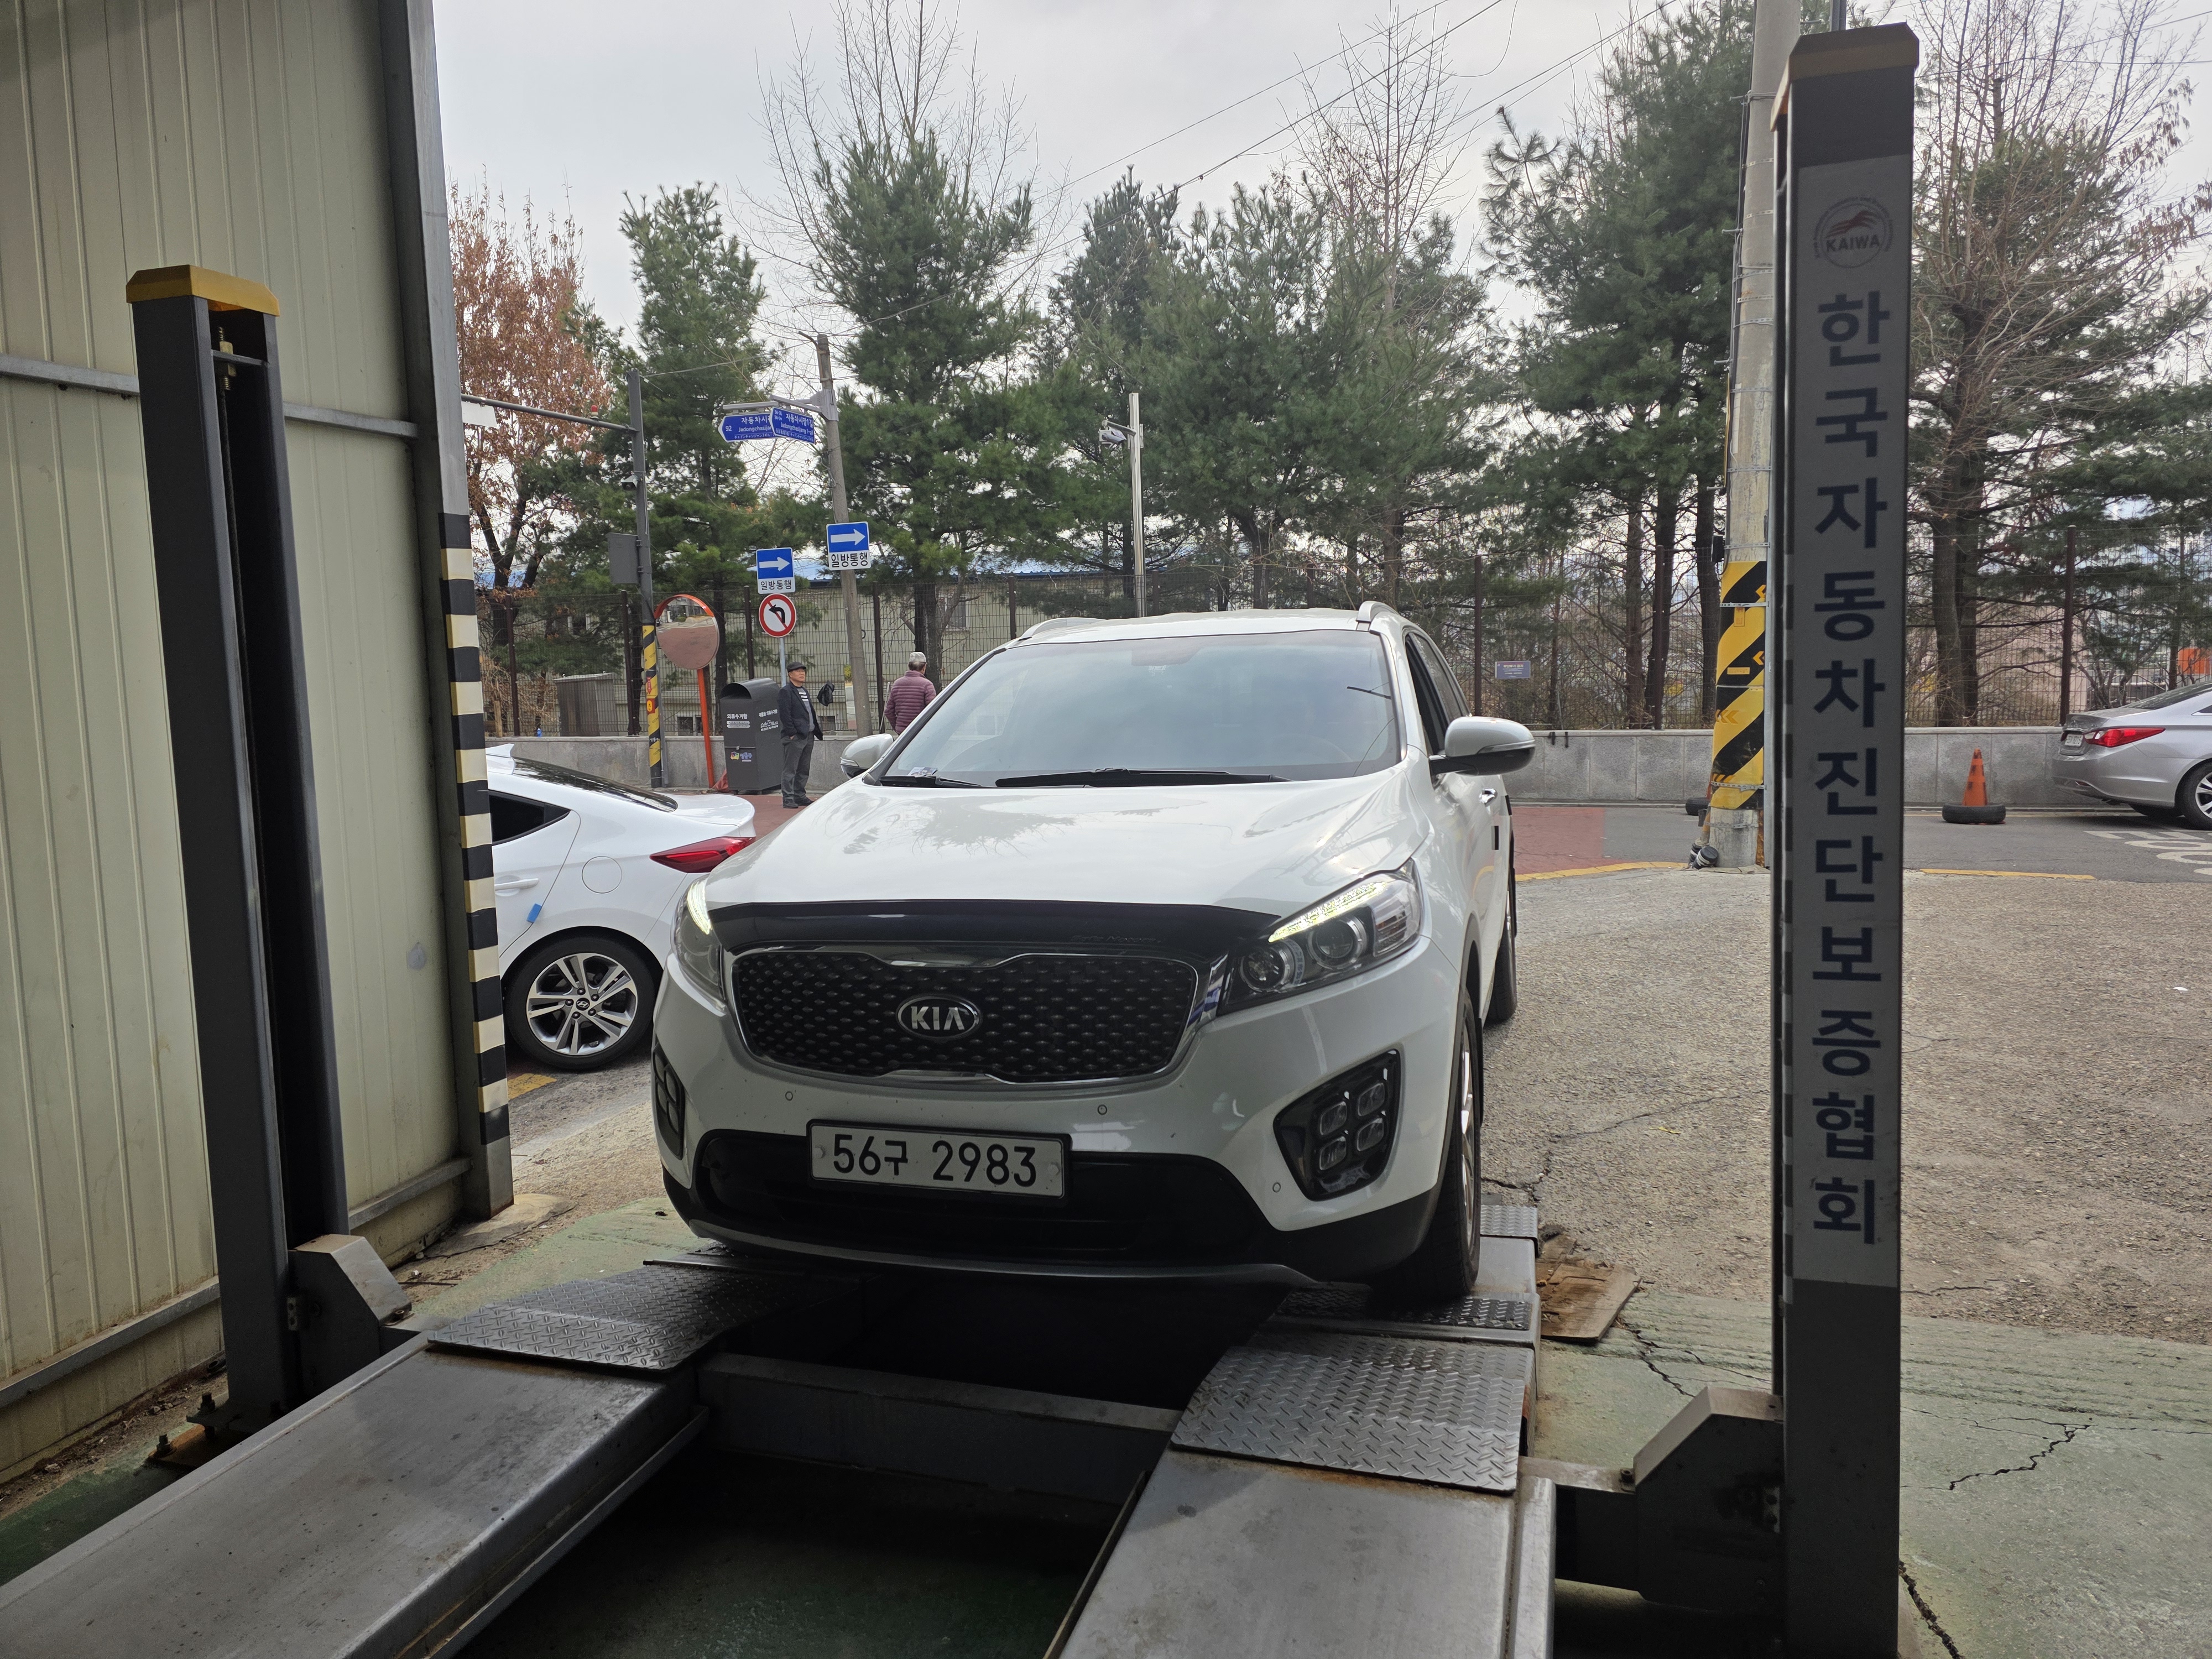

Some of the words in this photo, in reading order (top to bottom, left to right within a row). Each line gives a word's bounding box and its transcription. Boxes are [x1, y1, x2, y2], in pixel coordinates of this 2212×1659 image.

[1826, 234, 1880, 252] KAIWA
[741, 415, 770, 425] 자동차시
[831, 552, 868, 568] 일방통행
[760, 580, 792, 591] 일방통행
[1813, 291, 1890, 1245] 한국자동차진단보증협회
[911, 1006, 965, 1030] KIA
[833, 1134, 909, 1176] 56구
[932, 1140, 1037, 1187] 2983
